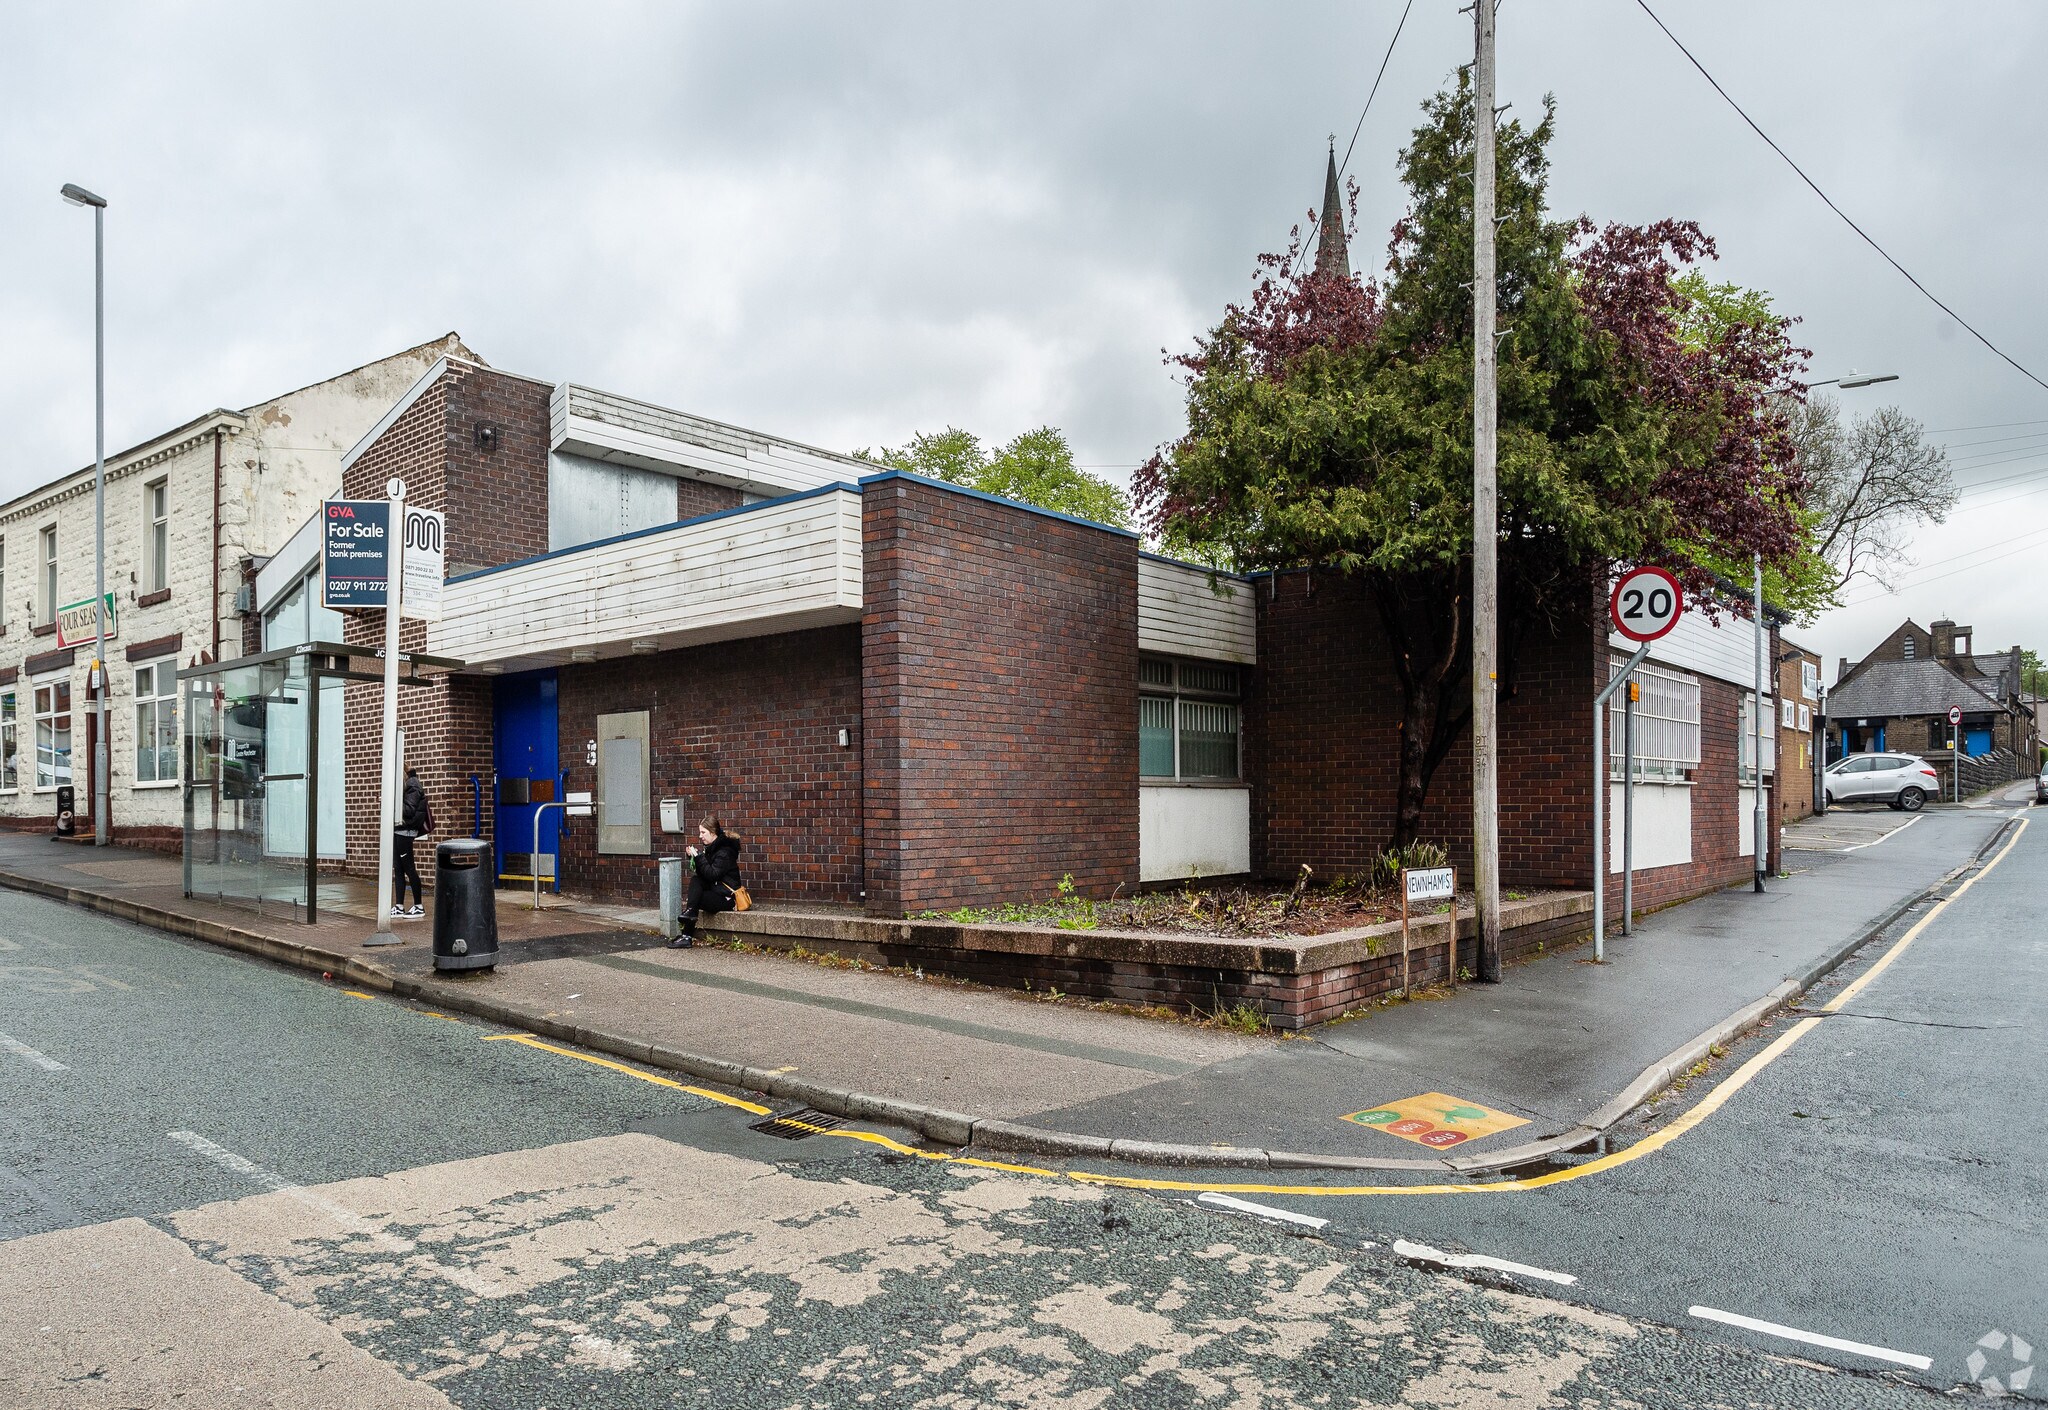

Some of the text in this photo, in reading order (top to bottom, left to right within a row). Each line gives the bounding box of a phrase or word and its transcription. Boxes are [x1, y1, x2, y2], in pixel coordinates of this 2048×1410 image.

[392, 480, 400, 496] J
[328, 505, 355, 518] GVA
[328, 522, 384, 538] For Sale
[329, 540, 356, 549] Former
[329, 549, 383, 560] bank premises
[329, 581, 351, 591] 0207
[353, 581, 367, 591] 911
[1623, 588, 1672, 619] 20
[59, 611, 79, 631] FOUR
